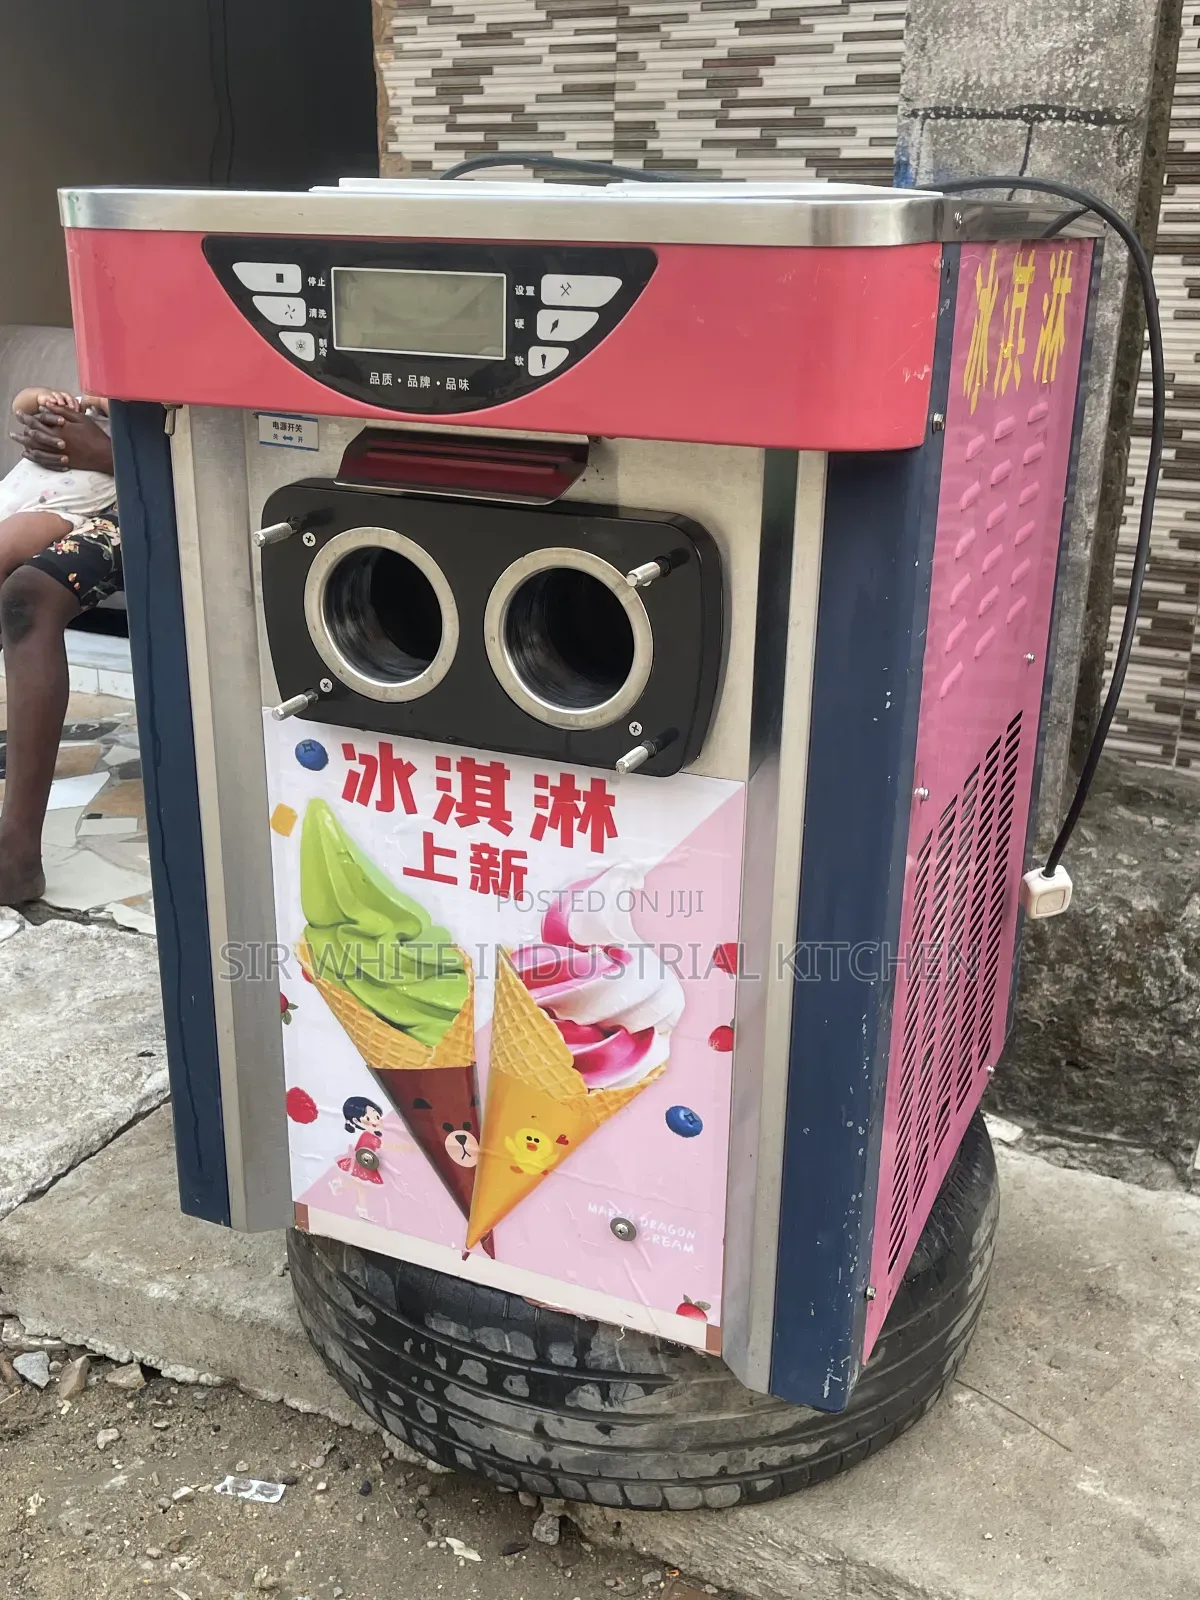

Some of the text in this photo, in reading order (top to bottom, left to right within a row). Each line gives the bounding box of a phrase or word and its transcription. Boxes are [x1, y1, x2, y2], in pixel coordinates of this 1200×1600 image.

[307, 276, 326, 288] 停止
[514, 285, 535, 296] 设置
[308, 307, 328, 319] 清洗
[514, 318, 525, 329] 硬
[318, 338, 328, 357] 制冷
[514, 355, 525, 366] 软
[272, 420, 303, 433] 电源开关
[341, 741, 619, 854] 冰淇淋
[402, 831, 528, 901] 上新
[640, 1216, 696, 1239] DRAGON
